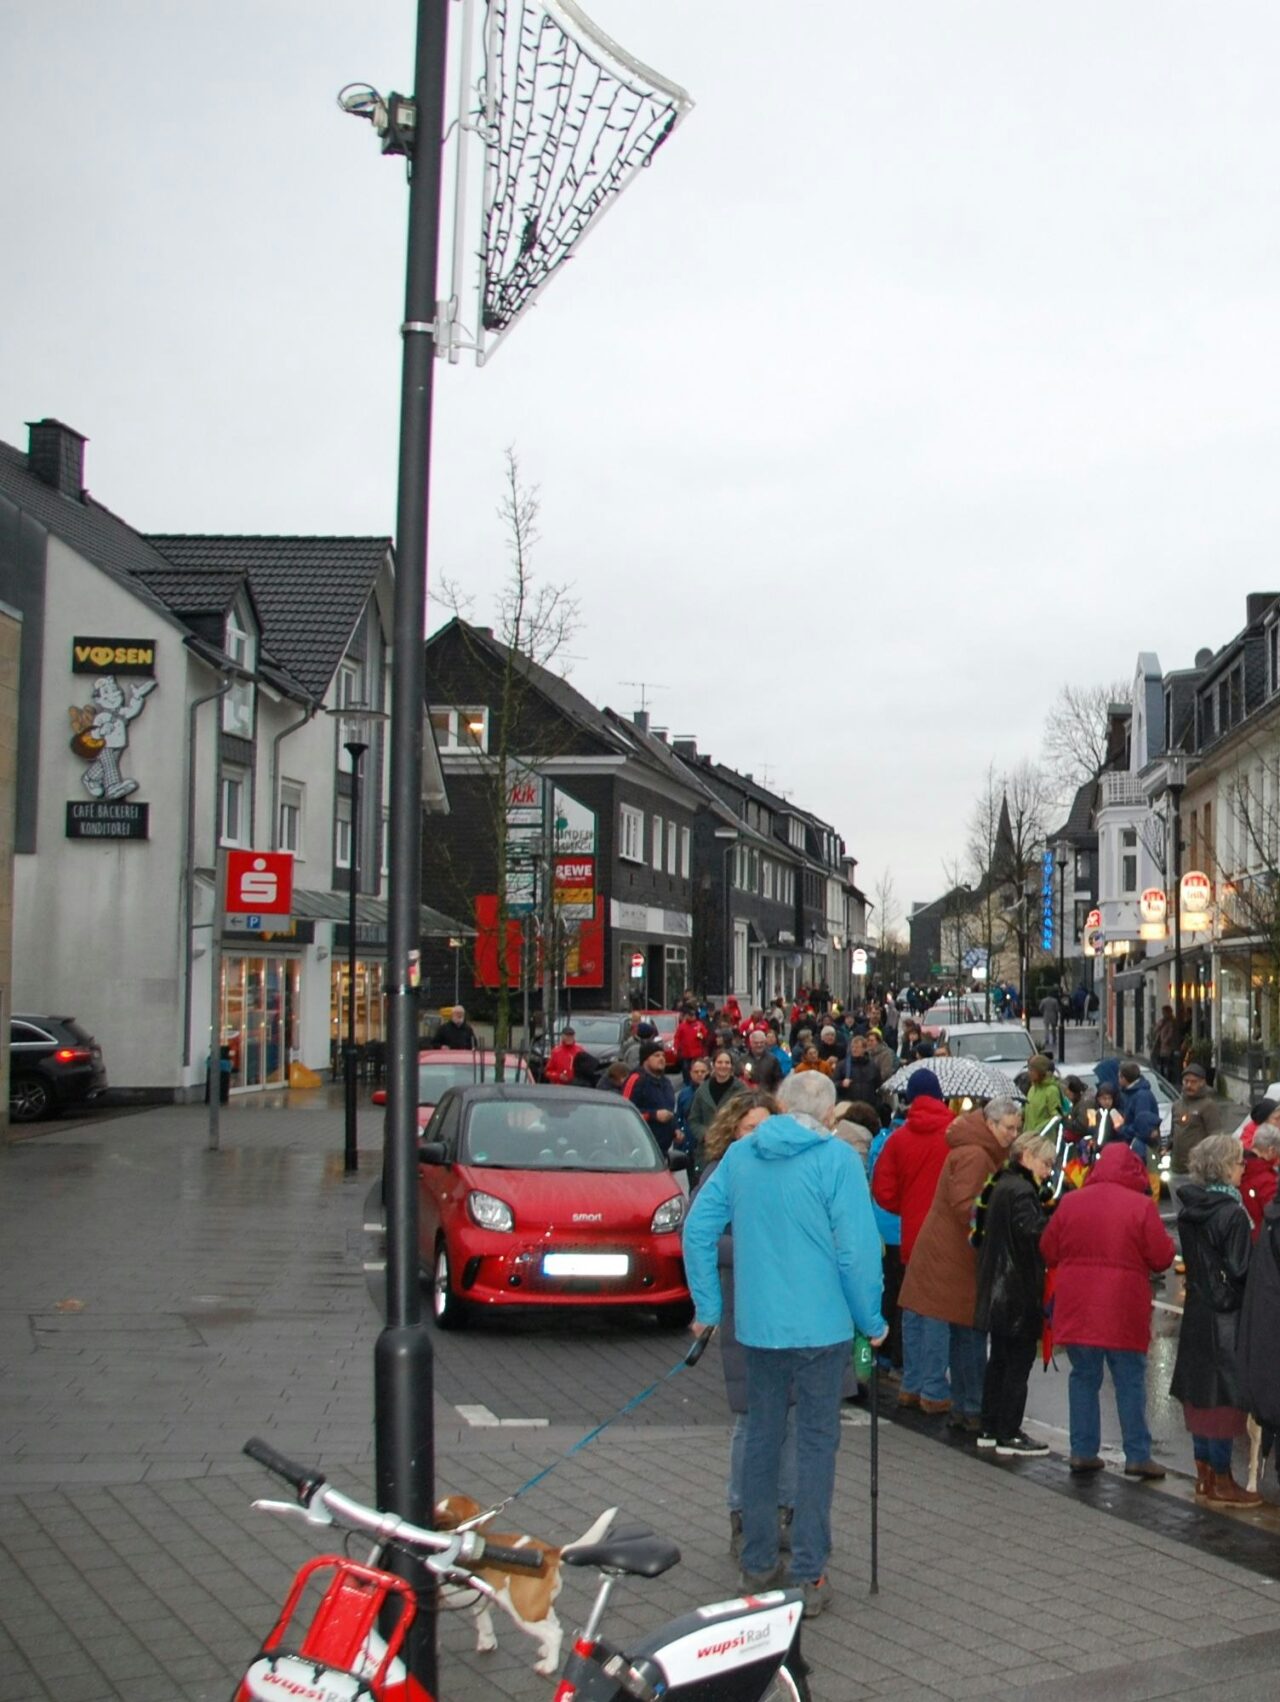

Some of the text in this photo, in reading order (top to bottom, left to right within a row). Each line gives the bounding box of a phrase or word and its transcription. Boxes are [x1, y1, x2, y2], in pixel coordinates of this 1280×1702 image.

[555, 864, 593, 877] REWE
[572, 1212, 603, 1222] smart
[697, 1630, 746, 1659] wupsi
[746, 1624, 771, 1643] Rad
[262, 1671, 327, 1701] wupsi
